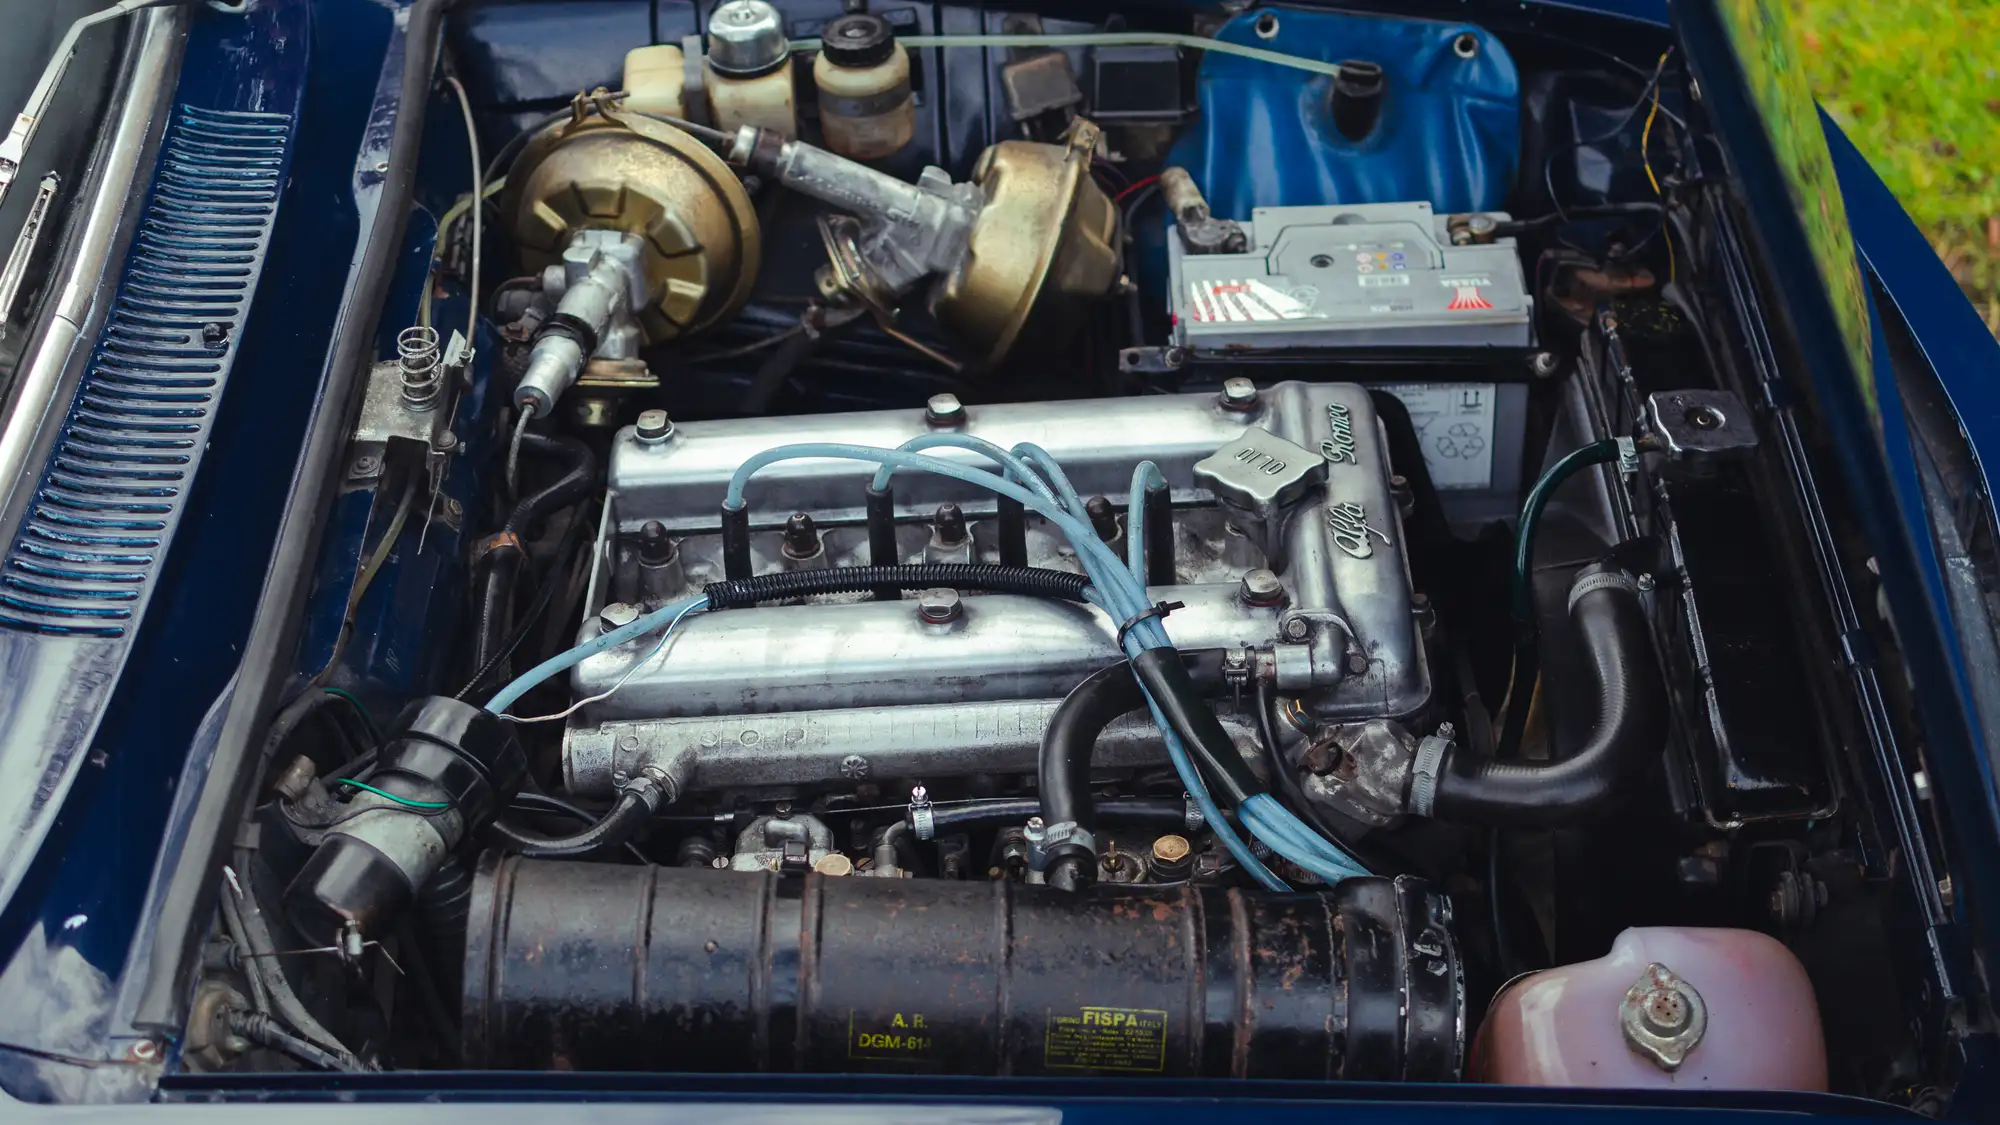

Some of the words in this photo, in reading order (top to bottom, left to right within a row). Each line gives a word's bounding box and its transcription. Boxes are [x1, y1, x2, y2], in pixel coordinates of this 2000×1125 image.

[1320, 402, 1357, 464] Romeo
[1235, 447, 1287, 475] OLIO
[1329, 502, 1391, 559] Alfa
[1083, 1011, 1138, 1027] FISPA
